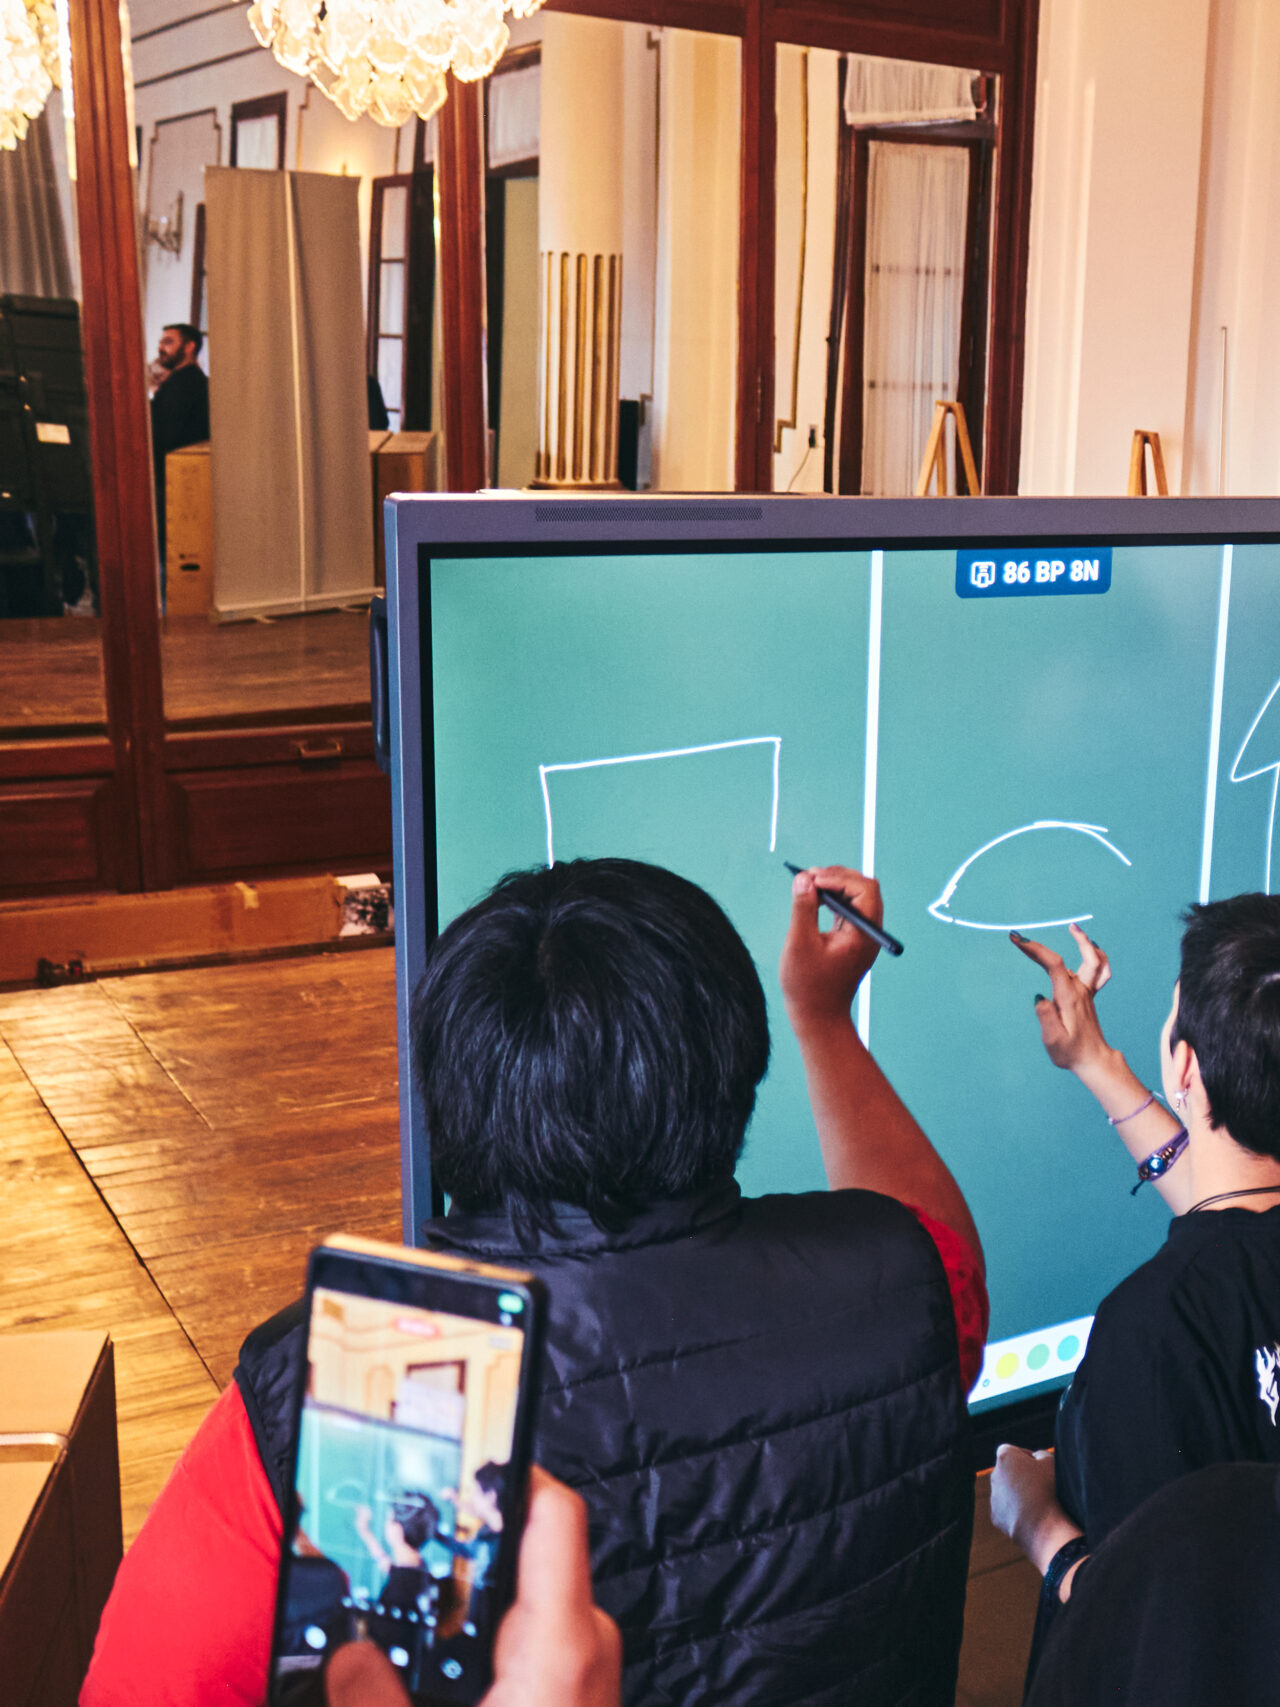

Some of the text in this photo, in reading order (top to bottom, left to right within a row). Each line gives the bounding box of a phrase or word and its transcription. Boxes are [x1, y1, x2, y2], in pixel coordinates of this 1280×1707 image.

[1003, 559, 1099, 584] 86 BP 8N
